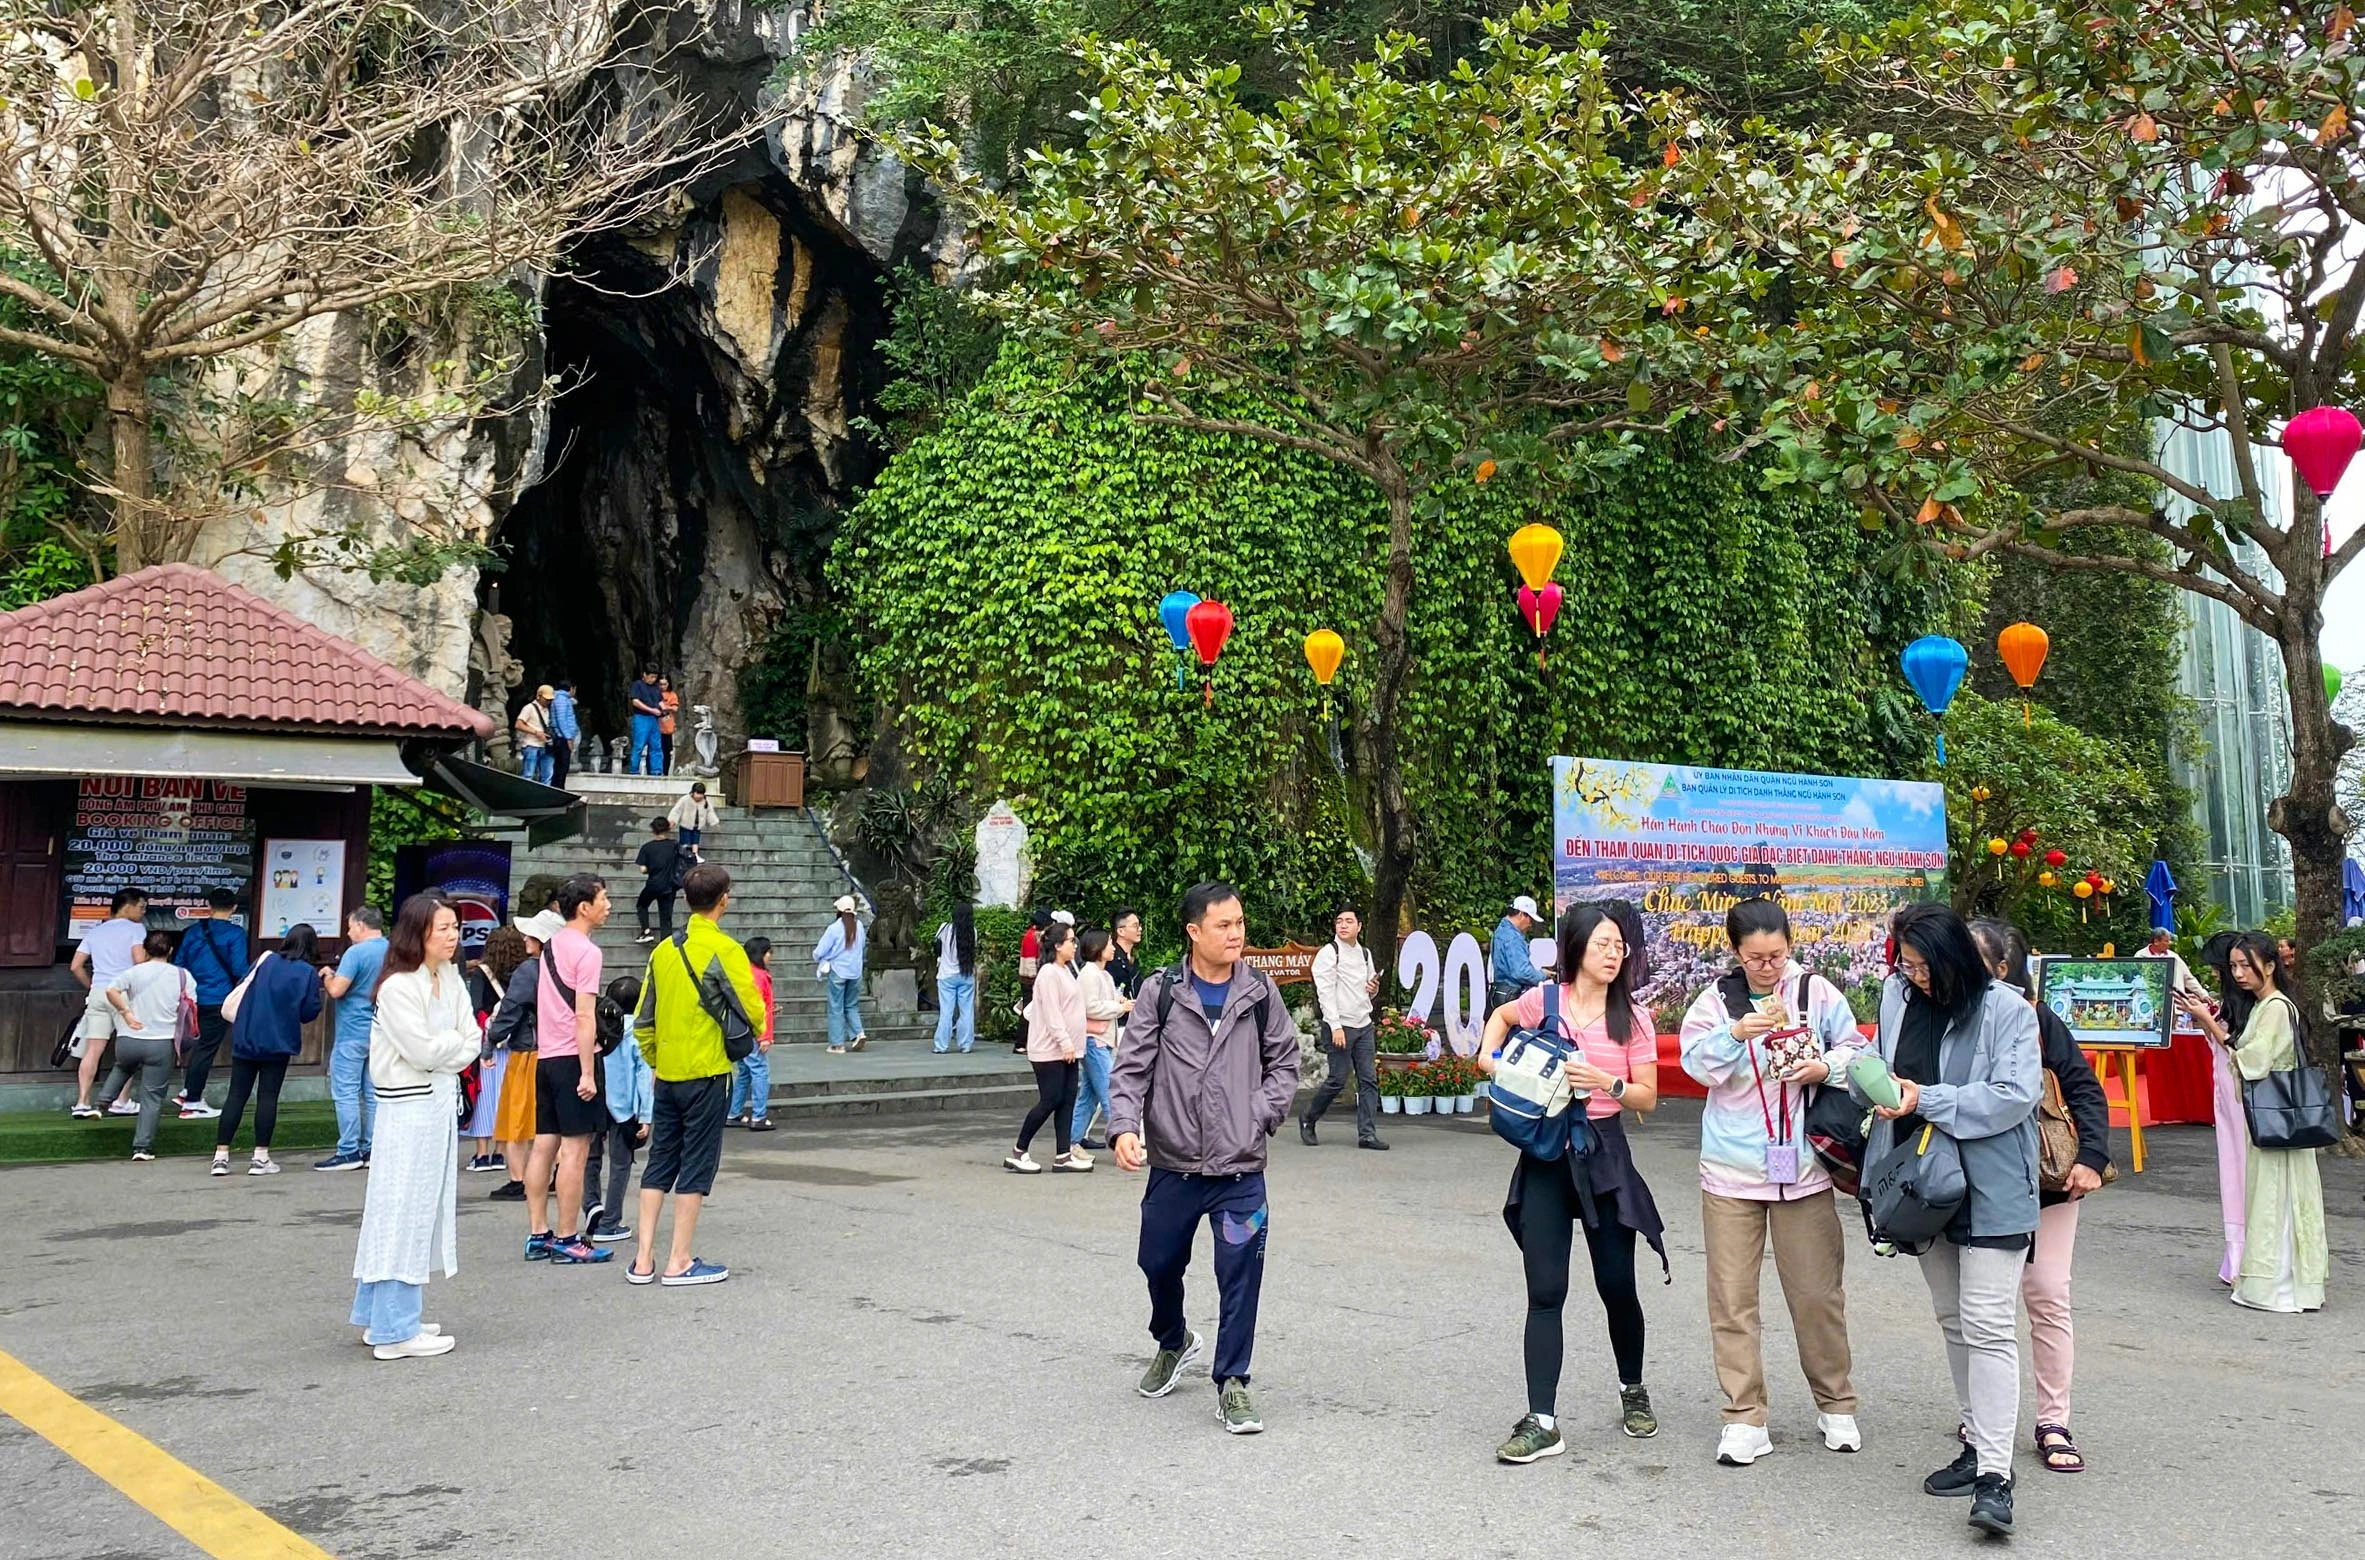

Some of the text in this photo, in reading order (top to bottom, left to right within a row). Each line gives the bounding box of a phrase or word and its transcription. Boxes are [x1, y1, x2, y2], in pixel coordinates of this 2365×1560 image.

[1705, 772, 1720, 780] BAN
[1682, 784, 1696, 792] BAN
[1754, 788, 1773, 797] DANH
[76, 813, 244, 830] BOOKING OFFICE
[68, 840, 132, 852] 20.000
[1566, 834, 1591, 857] ĐẾN
[1594, 840, 1628, 858] THAM
[1632, 842, 1663, 860] QUAN
[1666, 844, 1679, 860] DI
[1741, 846, 1760, 863] GIA
[1811, 848, 1838, 865] DANH
[95, 852, 120, 861] The
[122, 853, 182, 863] entrance
[83, 863, 137, 874] 20.000
[1848, 893, 1889, 913] 2025
[1244, 951, 1312, 968] THANG MÁY
[1261, 969, 1301, 977] LEVATOR
